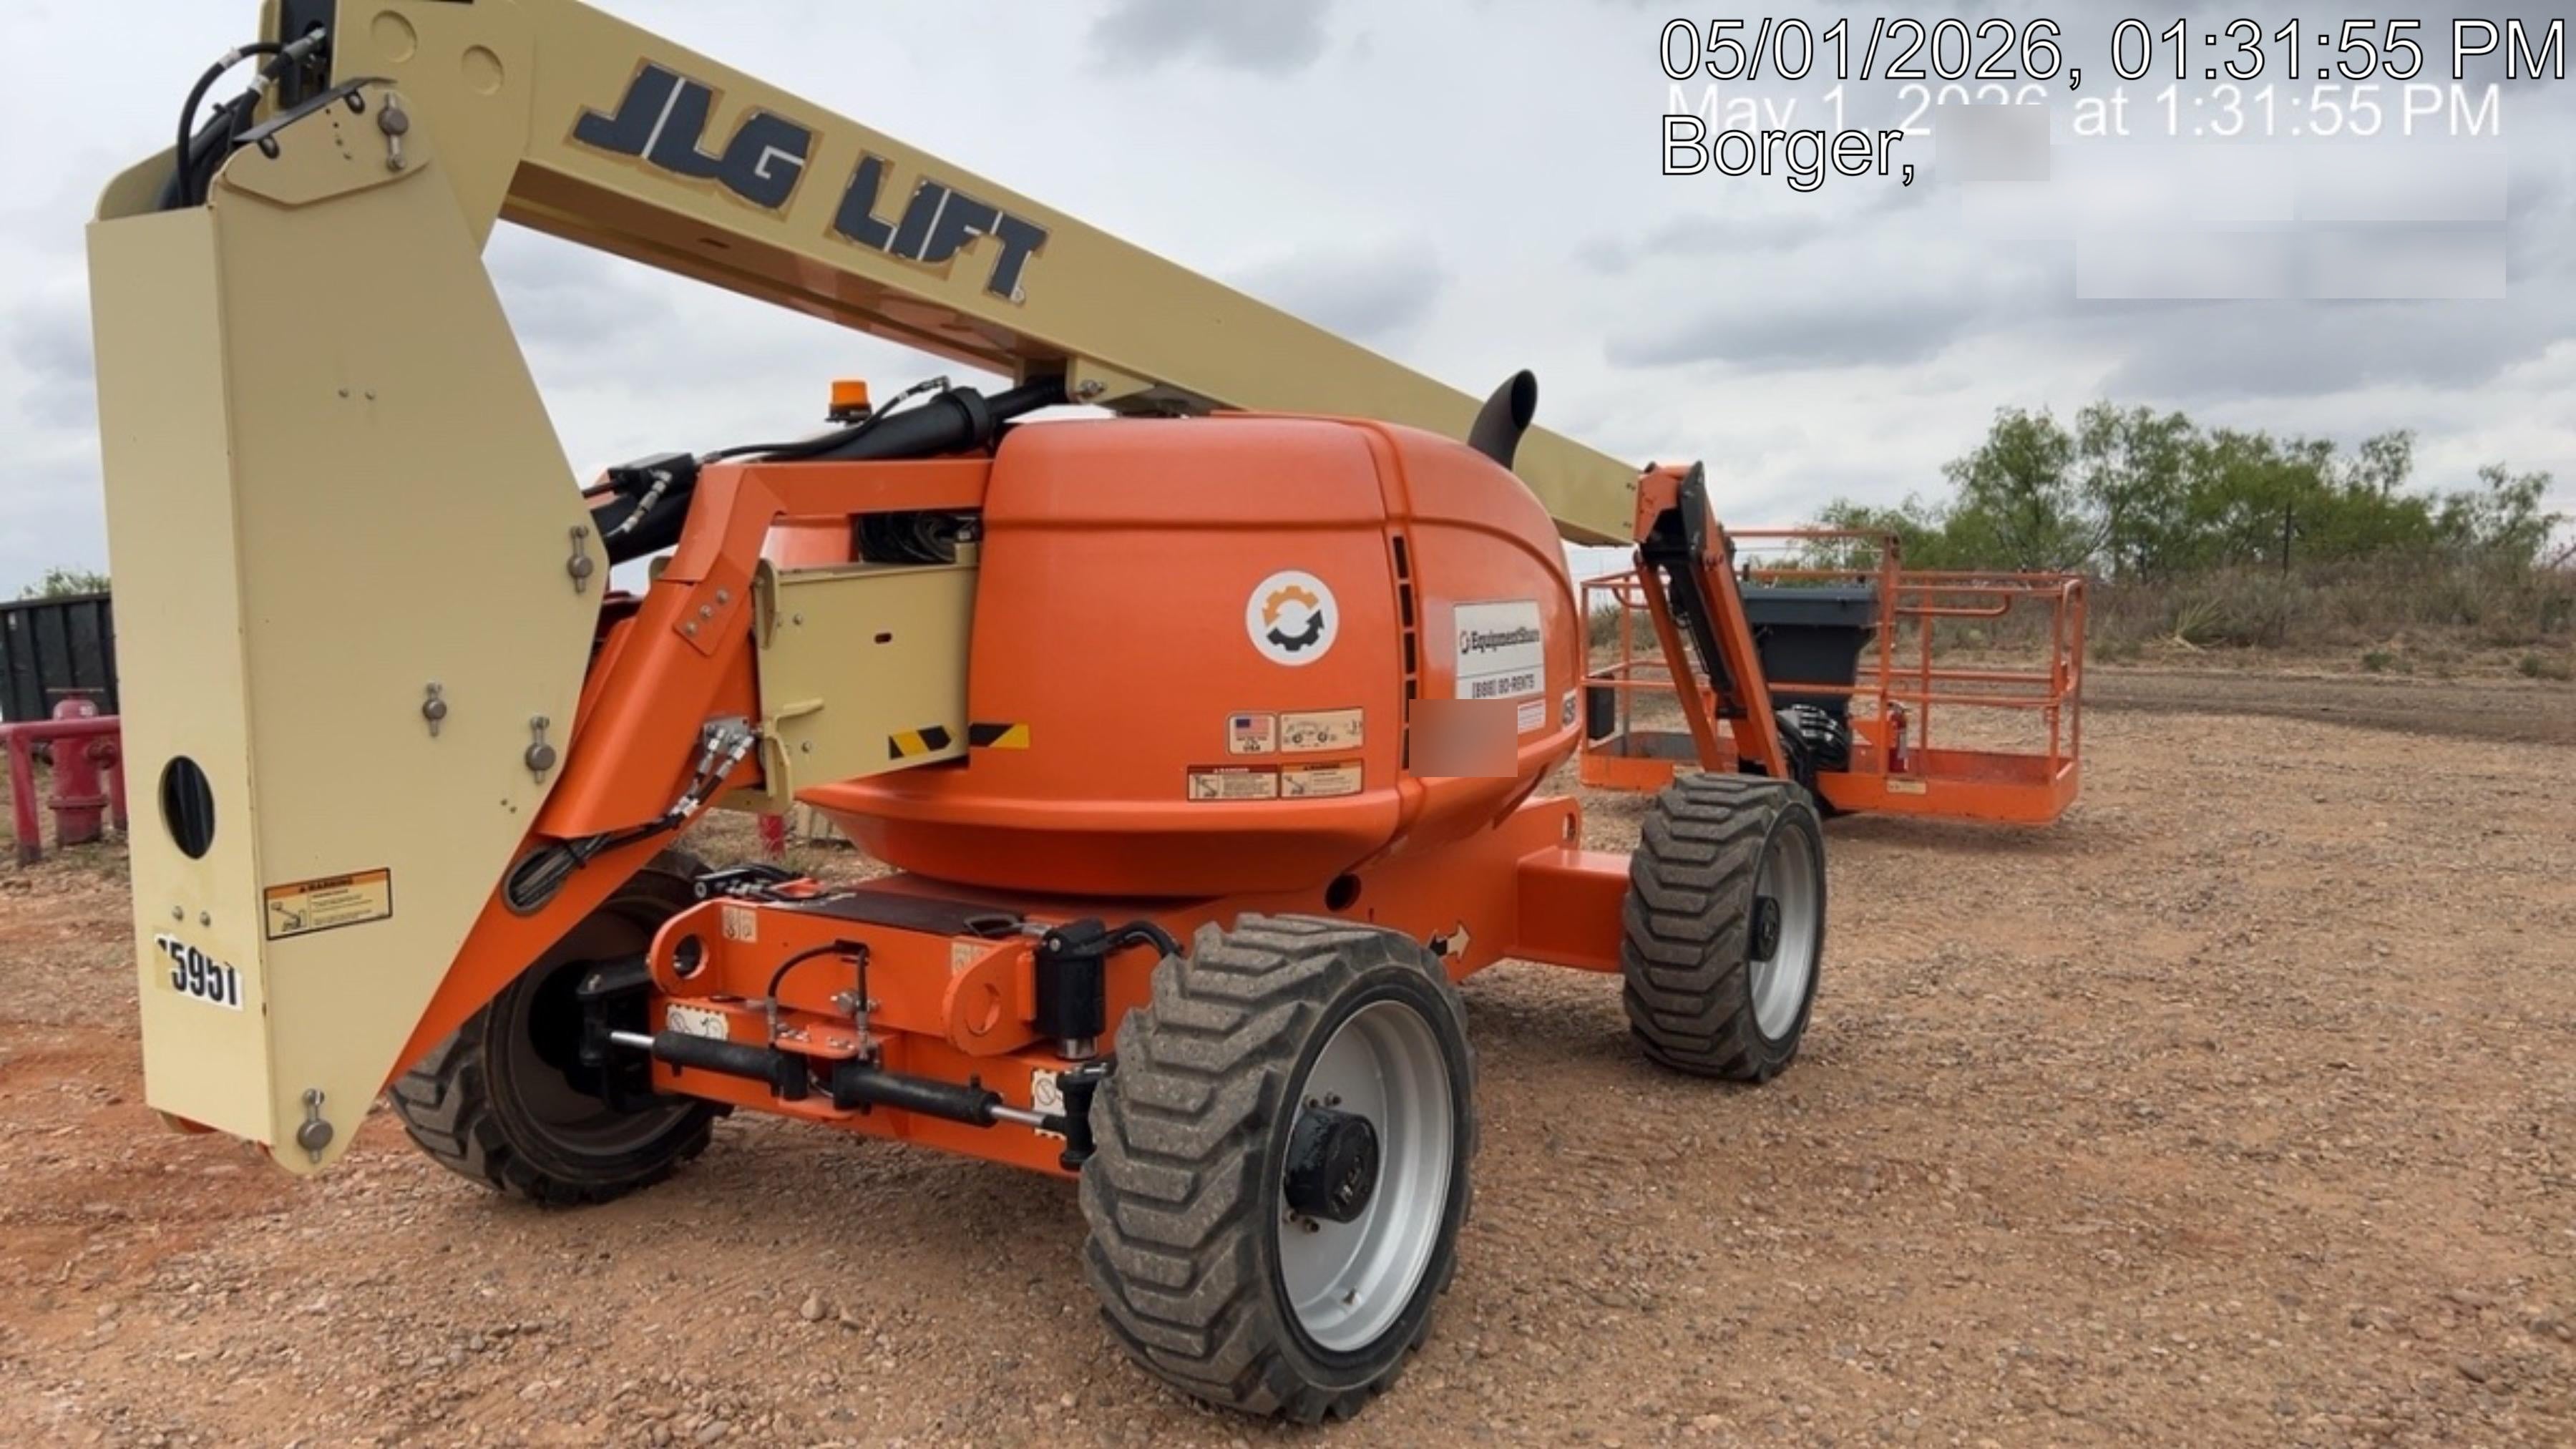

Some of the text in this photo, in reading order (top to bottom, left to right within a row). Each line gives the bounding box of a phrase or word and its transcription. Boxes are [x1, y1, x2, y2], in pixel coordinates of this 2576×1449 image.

[572, 64, 1049, 301] JLG LIFT
[158, 937, 237, 1005] 5951
